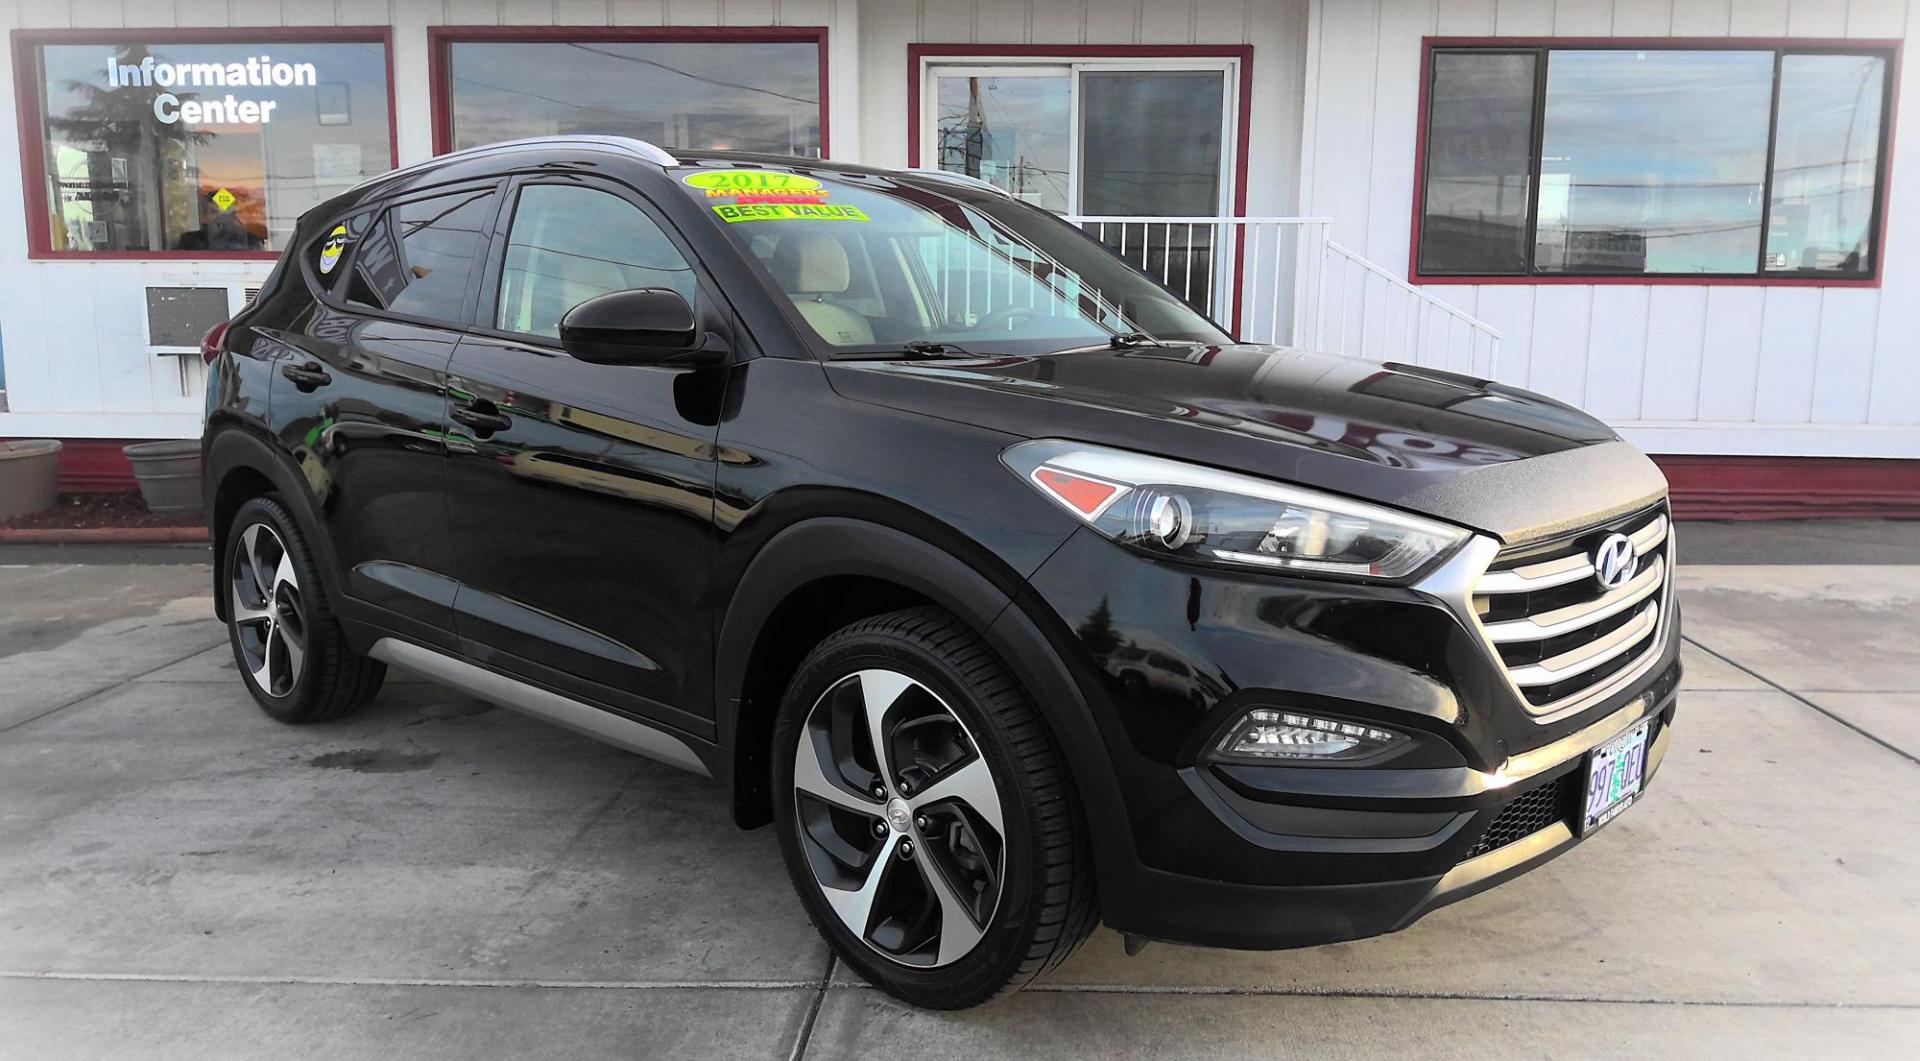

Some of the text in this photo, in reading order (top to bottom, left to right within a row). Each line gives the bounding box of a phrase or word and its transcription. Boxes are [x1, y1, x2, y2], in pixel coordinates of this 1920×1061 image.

[108, 56, 316, 87] Information
[153, 93, 276, 125] Center
[709, 173, 790, 188] 2017
[705, 188, 830, 199] MANAGERS
[719, 204, 858, 219] BEST VALUE
[1587, 759, 1616, 813] 997
